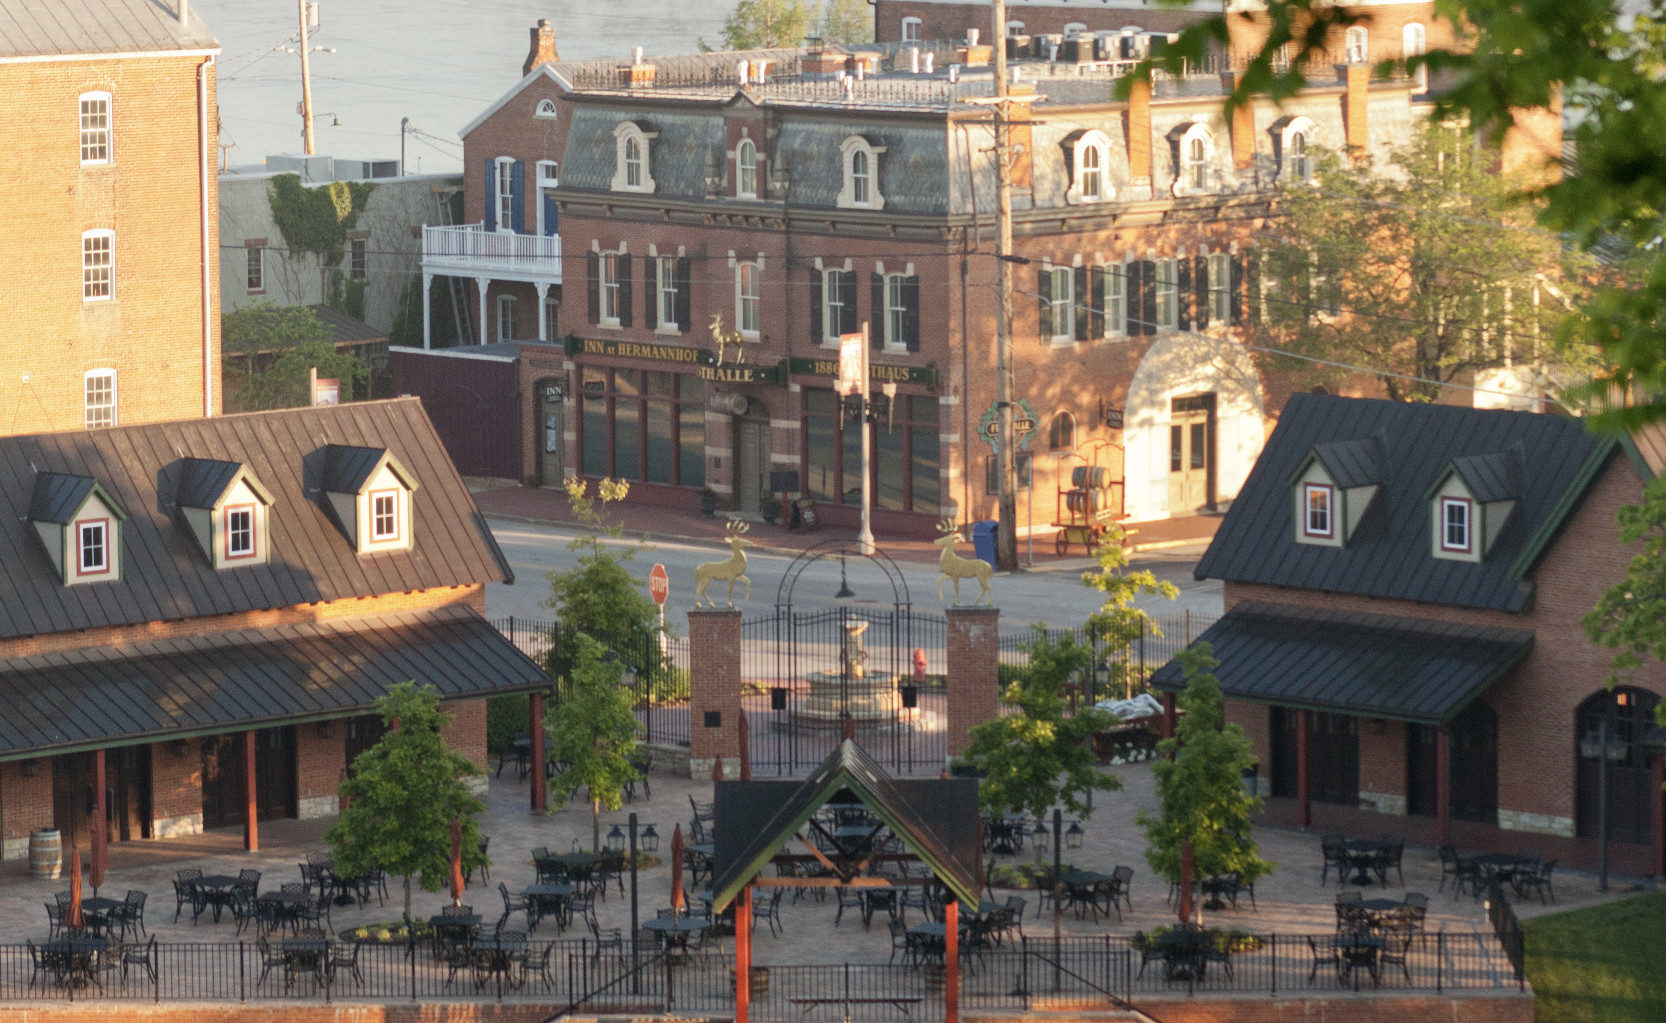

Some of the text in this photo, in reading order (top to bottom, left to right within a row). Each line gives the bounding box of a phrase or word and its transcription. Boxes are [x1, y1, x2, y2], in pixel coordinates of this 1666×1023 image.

[584, 340, 604, 353] INN
[618, 343, 699, 362] HERMANNHOF
[869, 364, 910, 381] THAUS
[546, 386, 561, 396] INN
[651, 576, 666, 593] STOP
